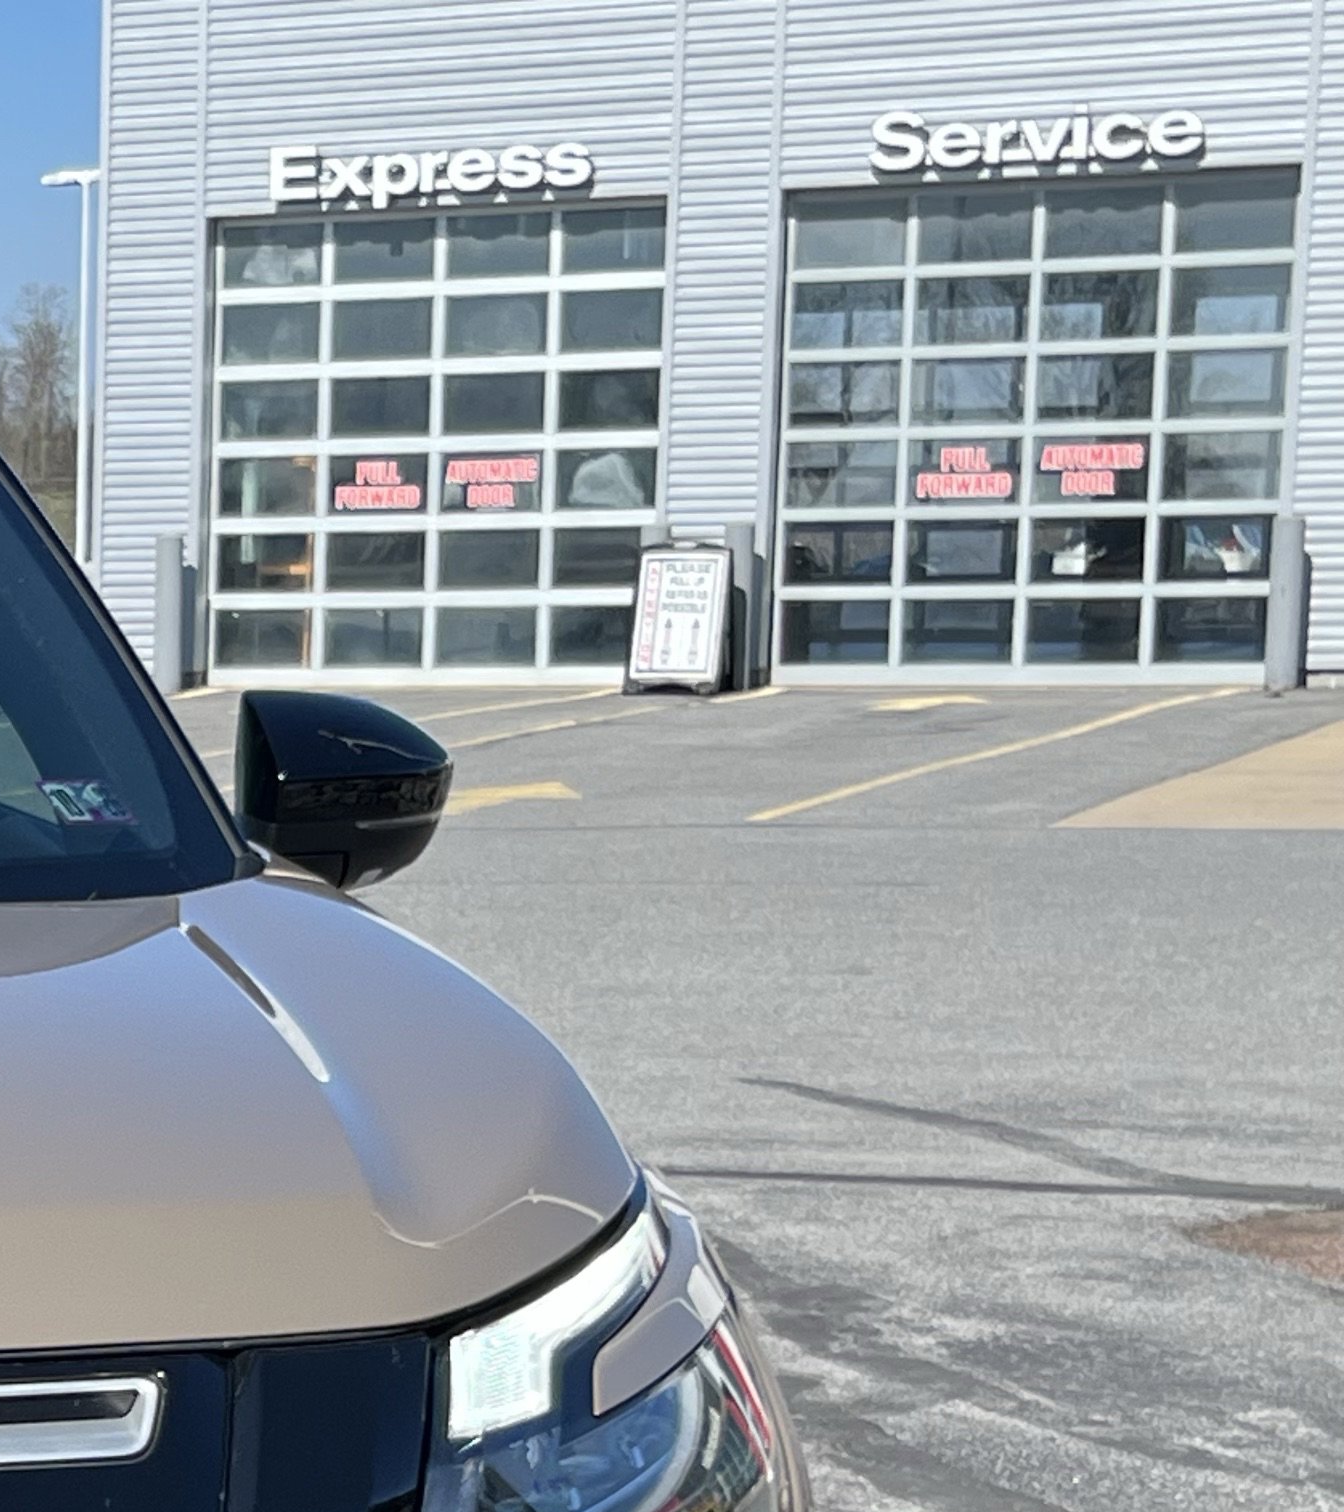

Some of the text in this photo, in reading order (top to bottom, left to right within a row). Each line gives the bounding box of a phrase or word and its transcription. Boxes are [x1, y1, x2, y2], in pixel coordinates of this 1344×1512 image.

[269, 102, 1205, 209] Express Service
[941, 447, 991, 472] PULL
[1040, 443, 1144, 471] AUTOMATIC
[356, 460, 401, 485] PULL
[446, 458, 538, 484] AUTOMATIC
[1061, 471, 1115, 496] DOOR
[335, 485, 420, 510] FORWARD
[467, 484, 514, 508] DOOR
[917, 472, 1012, 498] FORWARD
[666, 563, 711, 574] PLEASE
